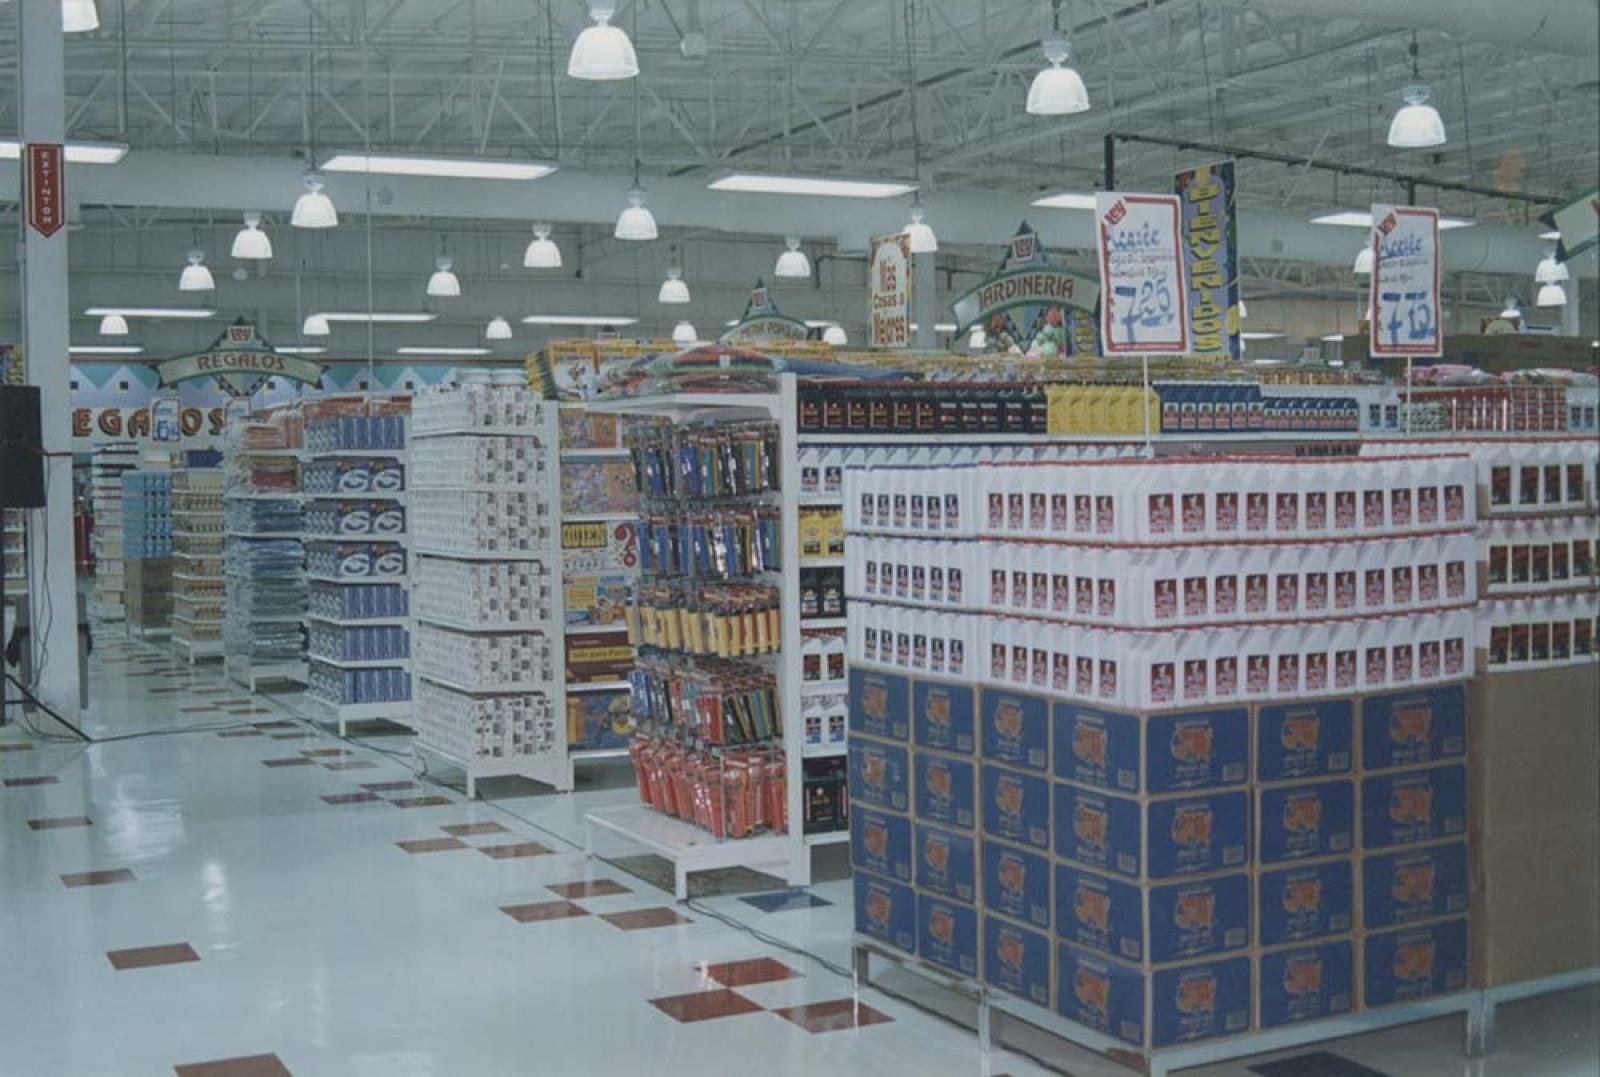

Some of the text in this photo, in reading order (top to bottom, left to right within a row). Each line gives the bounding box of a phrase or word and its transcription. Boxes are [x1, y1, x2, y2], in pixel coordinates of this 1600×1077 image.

[41, 151, 53, 225] EXTINTOR
[977, 274, 1075, 313] JARDINERIA
[197, 352, 286, 371] REGALOS
